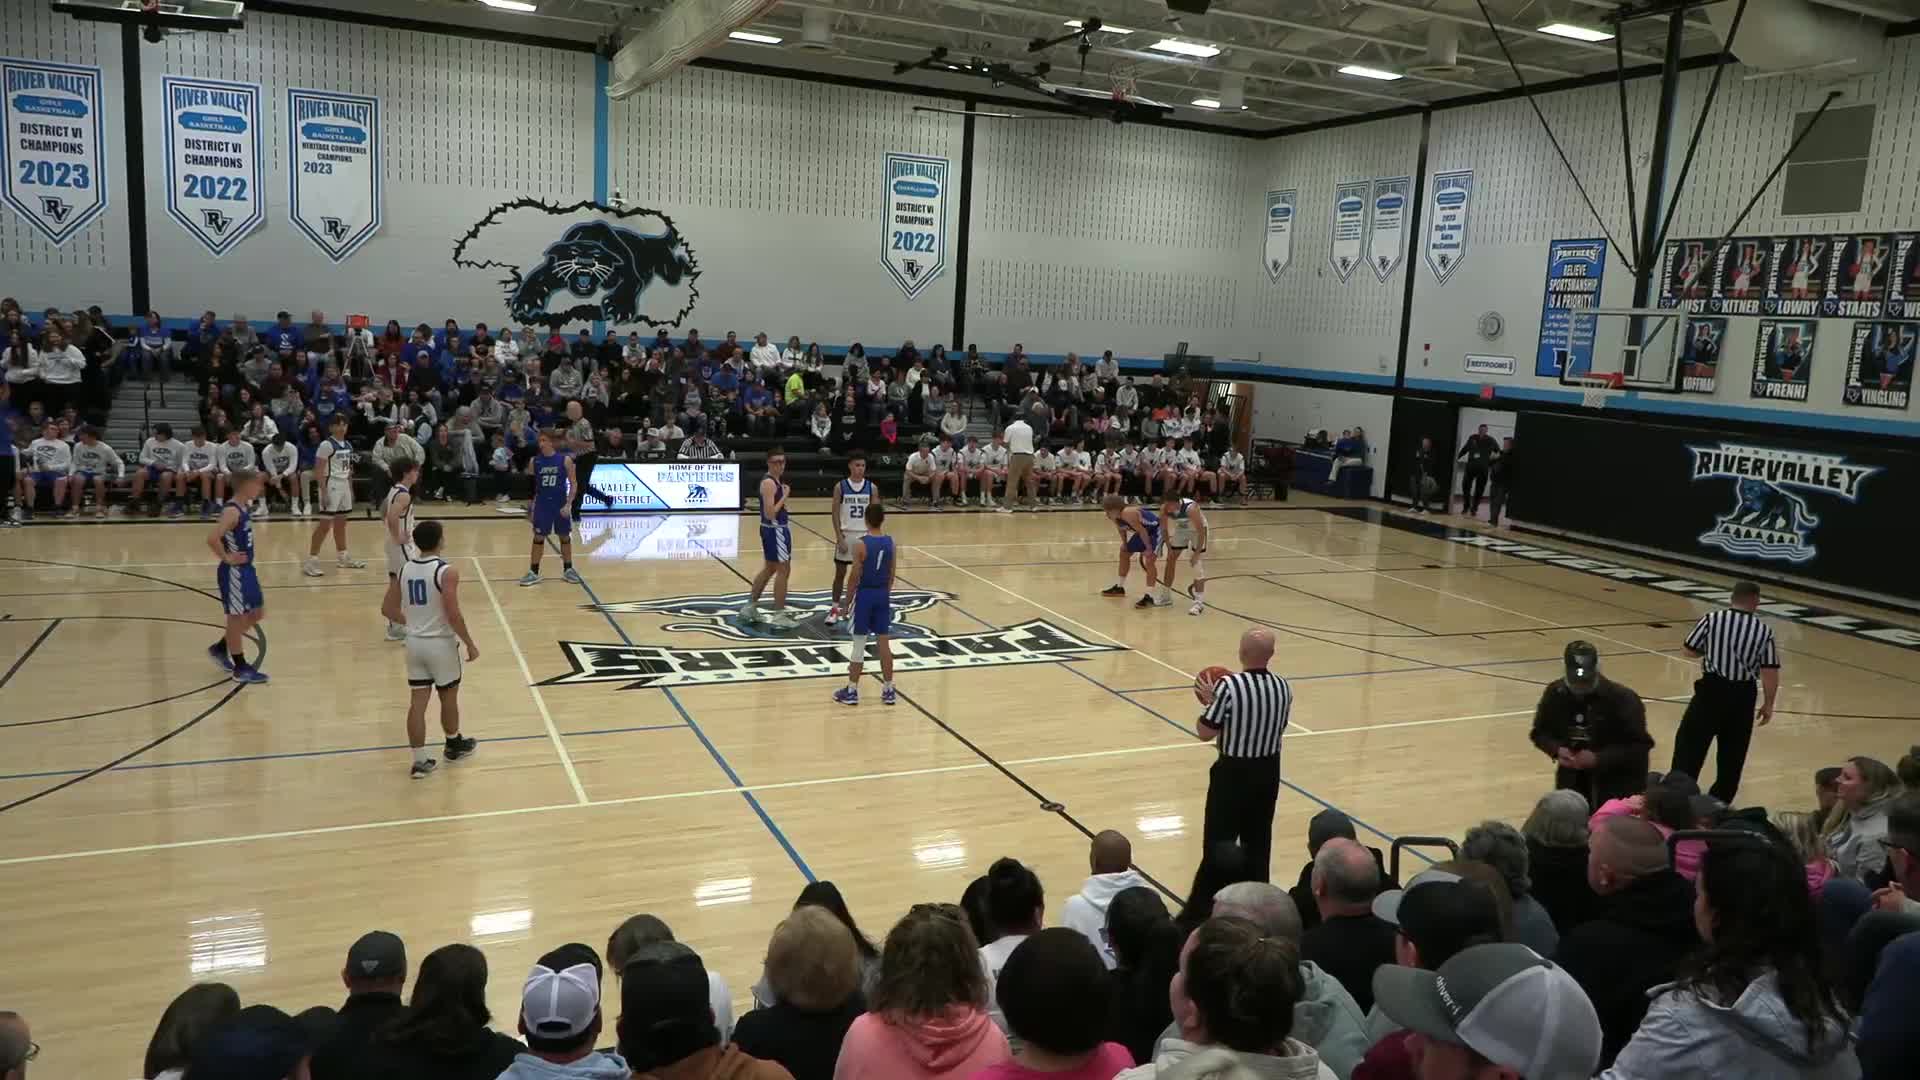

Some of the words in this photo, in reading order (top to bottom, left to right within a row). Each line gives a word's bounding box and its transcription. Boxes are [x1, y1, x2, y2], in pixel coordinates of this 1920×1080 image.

[8, 69, 45, 92] RIVER
[48, 72, 90, 99] VALLEY
[174, 87, 208, 110] RIVER
[210, 90, 249, 116] VALLEY
[299, 100, 330, 121] RIVER
[332, 102, 369, 126] VALLEY
[20, 122, 68, 138] DISTRICT
[72, 126, 82, 138] VI
[20, 139, 84, 155] CHAMPIONS
[184, 138, 229, 153] DISTRICT
[232, 143, 242, 154] VI
[184, 154, 242, 169] CHAMPIONS
[317, 153, 353, 163] CHAMPIONS
[19, 160, 90, 189] 2023
[303, 161, 333, 175] 2023
[892, 161, 914, 179] RIVER
[916, 163, 942, 184] VALLEY
[183, 174, 248, 201] 2022
[896, 202, 926, 214] DISTRICT
[927, 204, 934, 214] VI
[895, 214, 934, 226] CHAMPIONS
[892, 230, 935, 253] 2022
[1555, 248, 1599, 260] PANTHERS
[1563, 264, 1588, 276] BELIEVE
[1548, 278, 1598, 292] SPORTSMANSHIP
[1777, 300, 1819, 315] LOWRY
[1838, 301, 1881, 317] STAATS
[1862, 389, 1906, 406] YINGLING
[542, 475, 557, 487] 20
[657, 472, 734, 483] PANTHERS
[601, 483, 637, 492] VALLEY
[609, 495, 651, 504] ISTRICT
[850, 505, 864, 518] 23
[876, 550, 884, 570] 1
[407, 579, 427, 605] 10
[904, 654, 1040, 667] RIVER
